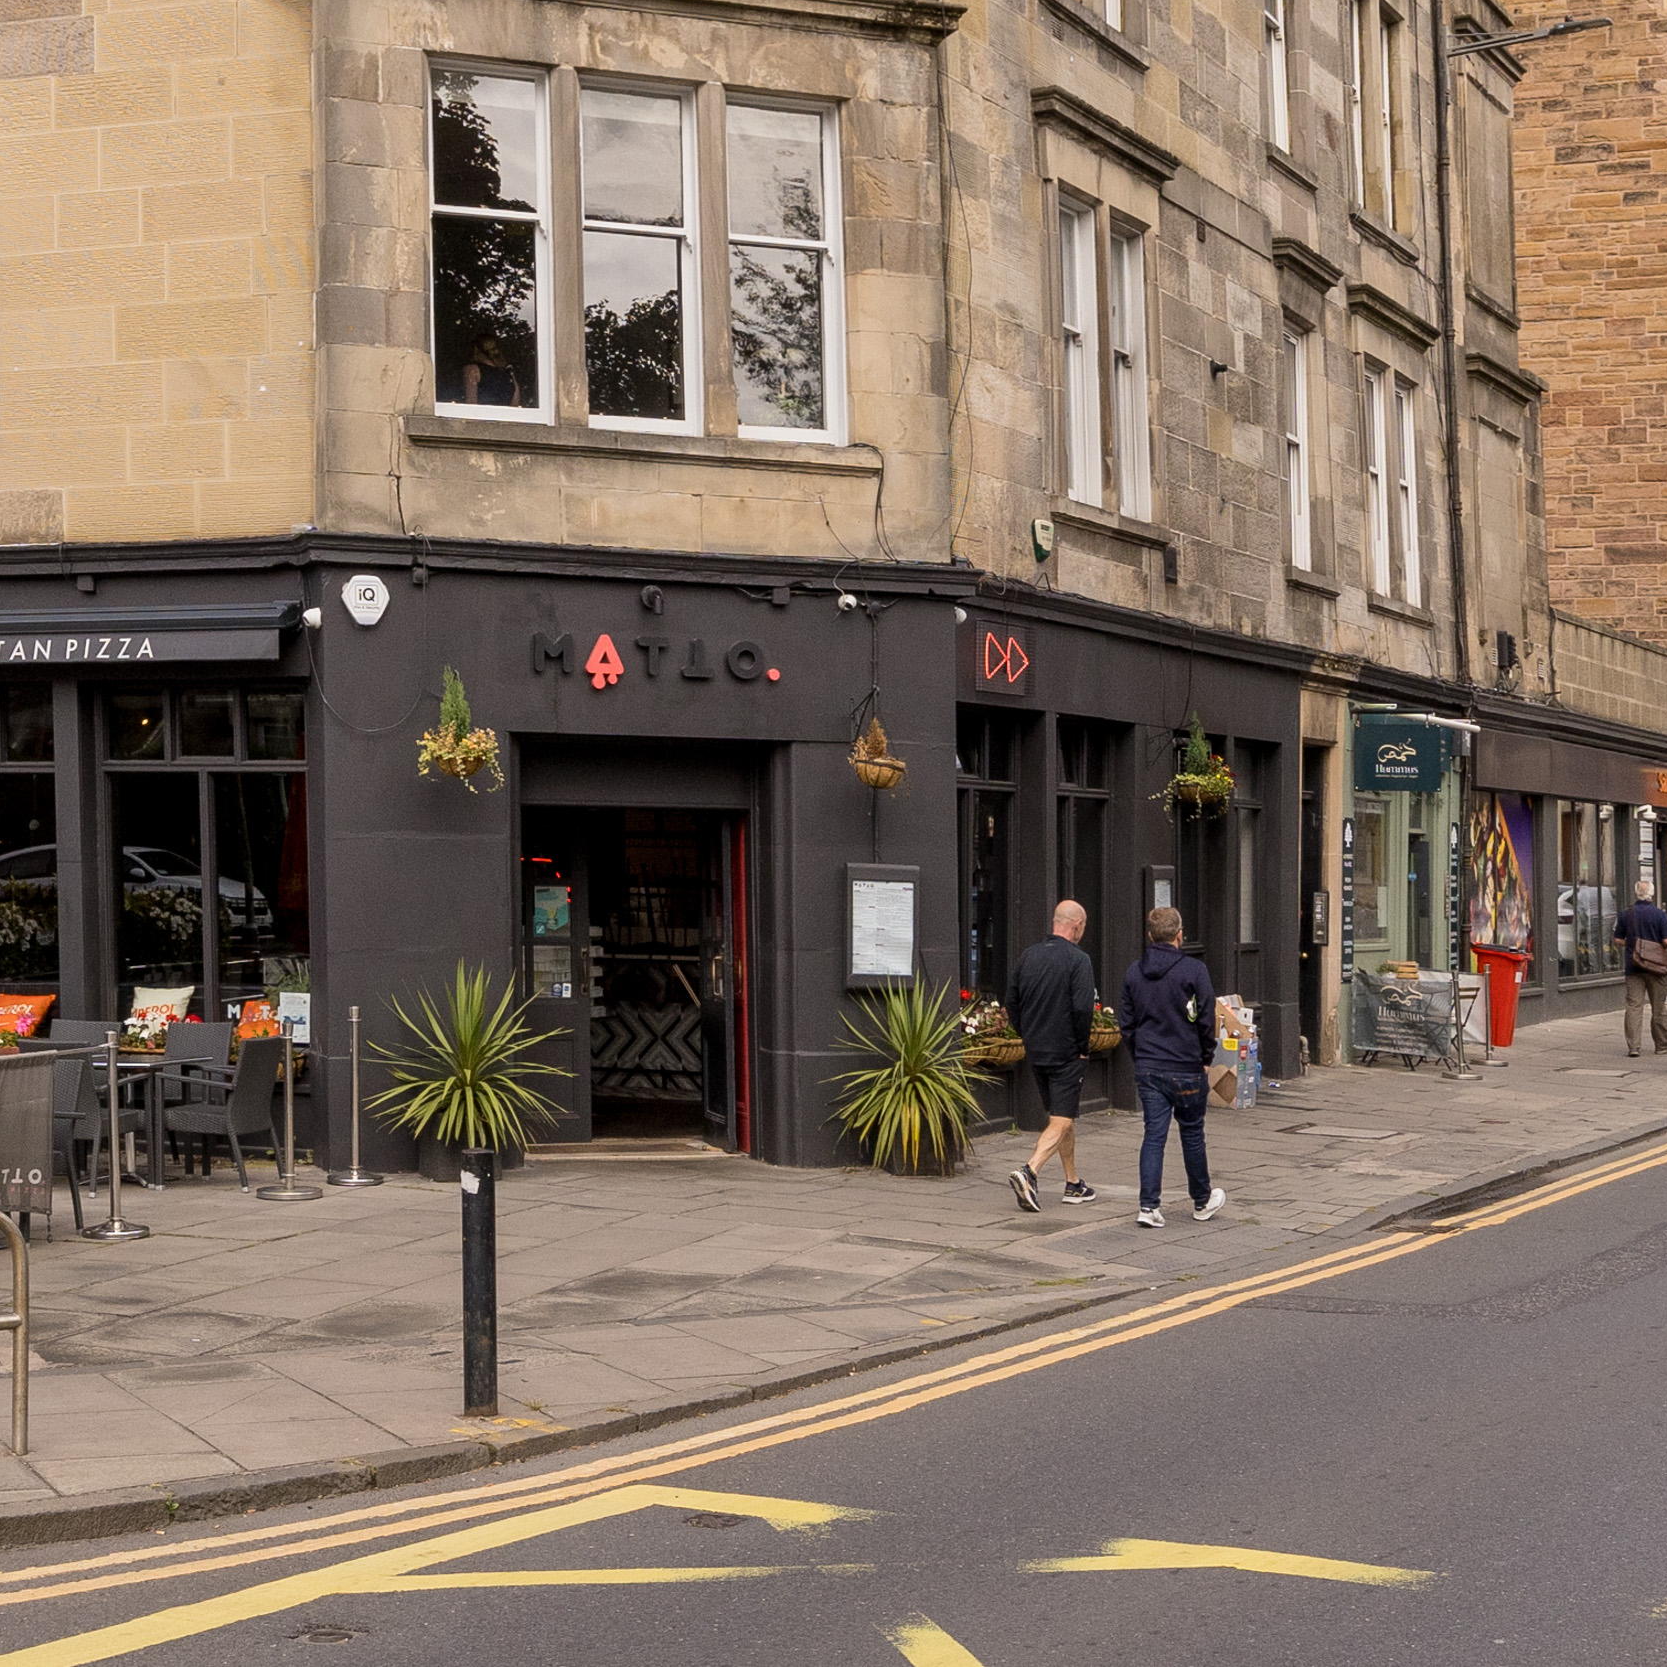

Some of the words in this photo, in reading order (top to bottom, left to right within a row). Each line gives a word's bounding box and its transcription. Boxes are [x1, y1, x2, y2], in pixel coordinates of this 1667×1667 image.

[358, 588, 375, 601] iQ
[65, 638, 154, 659] PIZZA
[1376, 764, 1419, 773] Hummus
